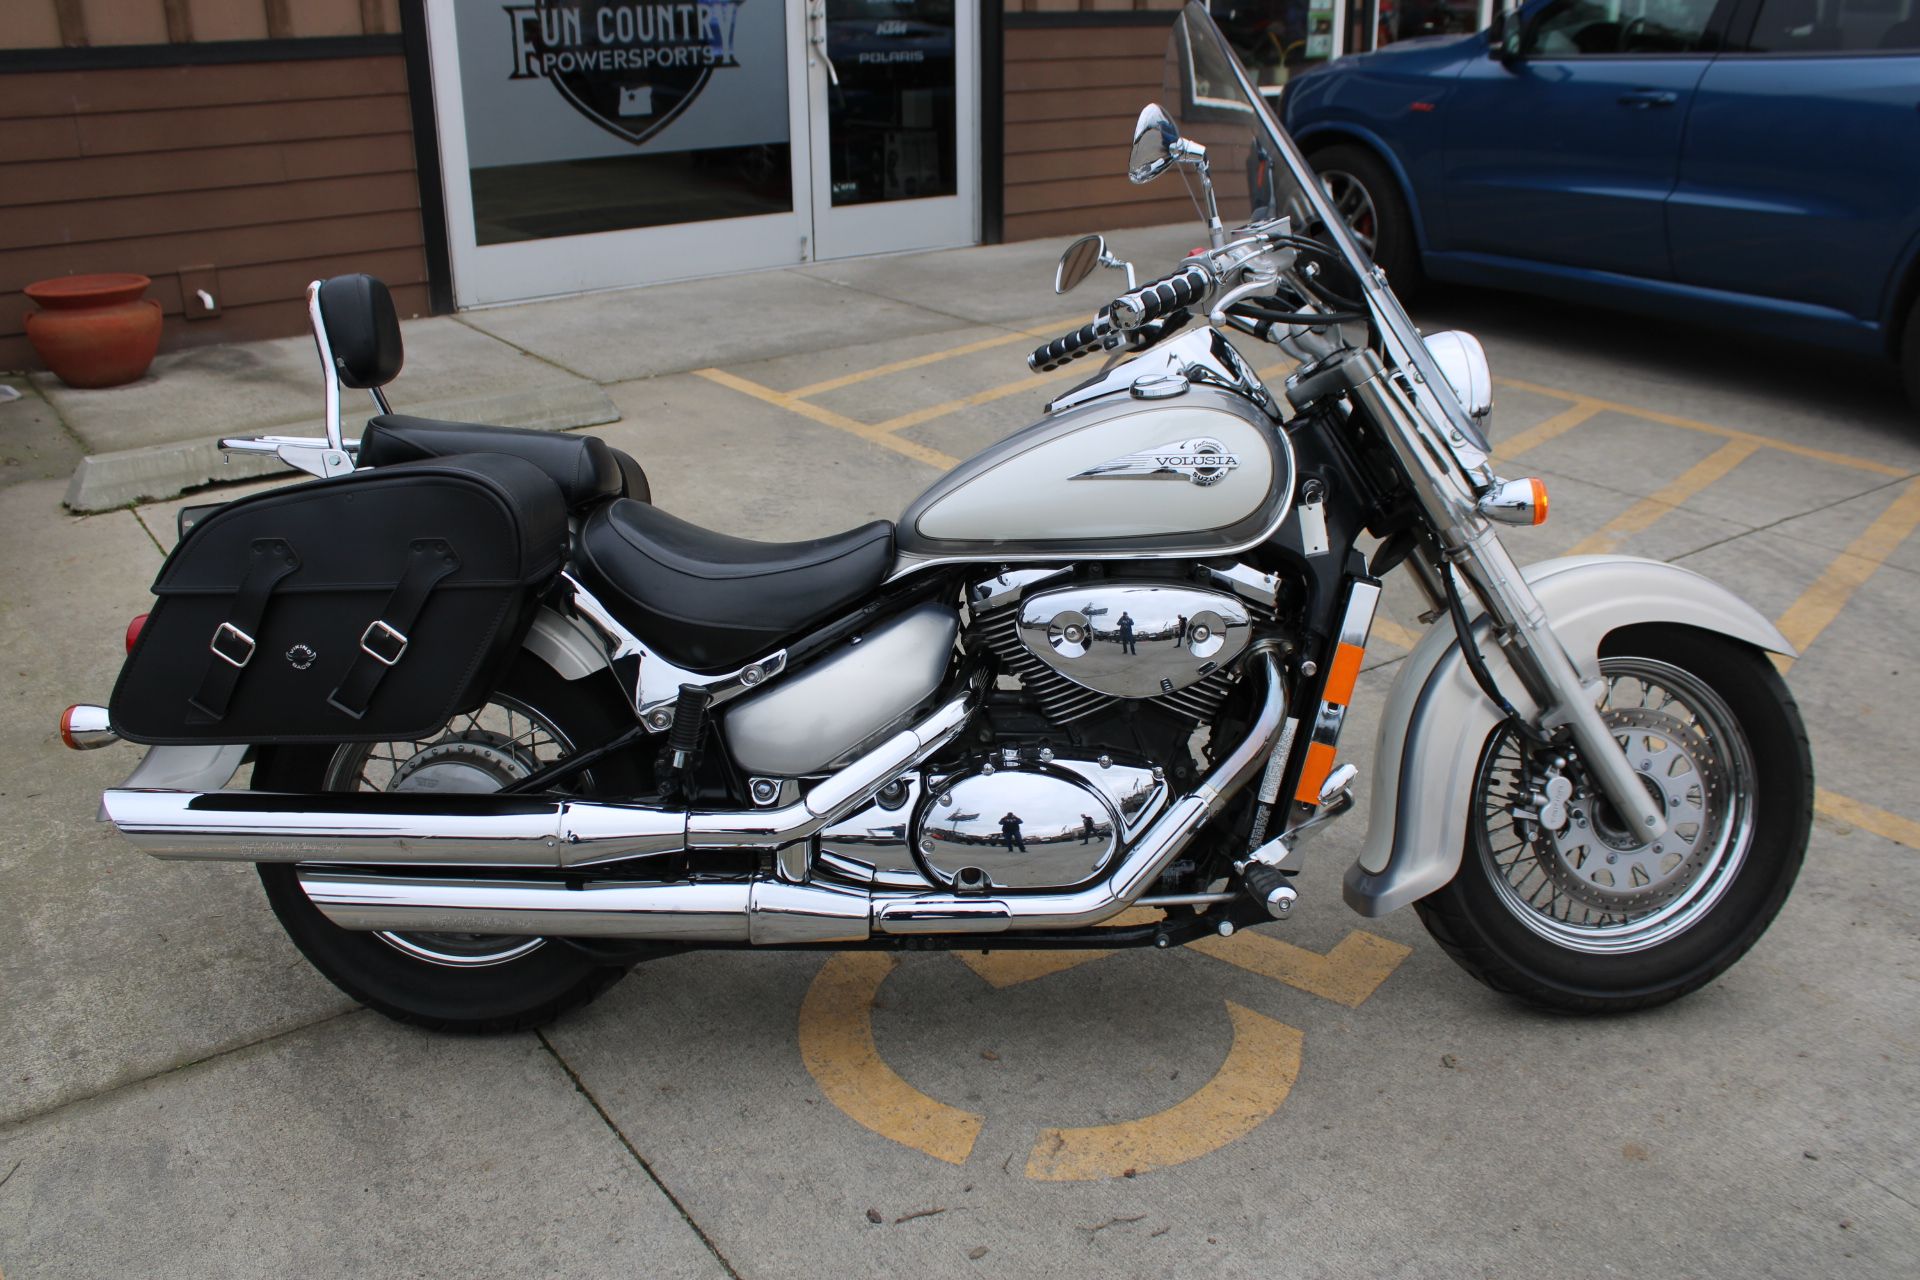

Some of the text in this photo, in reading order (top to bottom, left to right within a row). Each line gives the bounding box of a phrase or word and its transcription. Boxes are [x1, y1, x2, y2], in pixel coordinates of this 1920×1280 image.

[503, 3, 738, 78] FUN COUNTRY
[543, 46, 716, 72] POWERSPORTS
[858, 50, 924, 64] POLARIS
[1155, 456, 1237, 466] VOLUSIA
[1192, 471, 1224, 483] SUZUKI
[290, 645, 311, 655] VIKING
